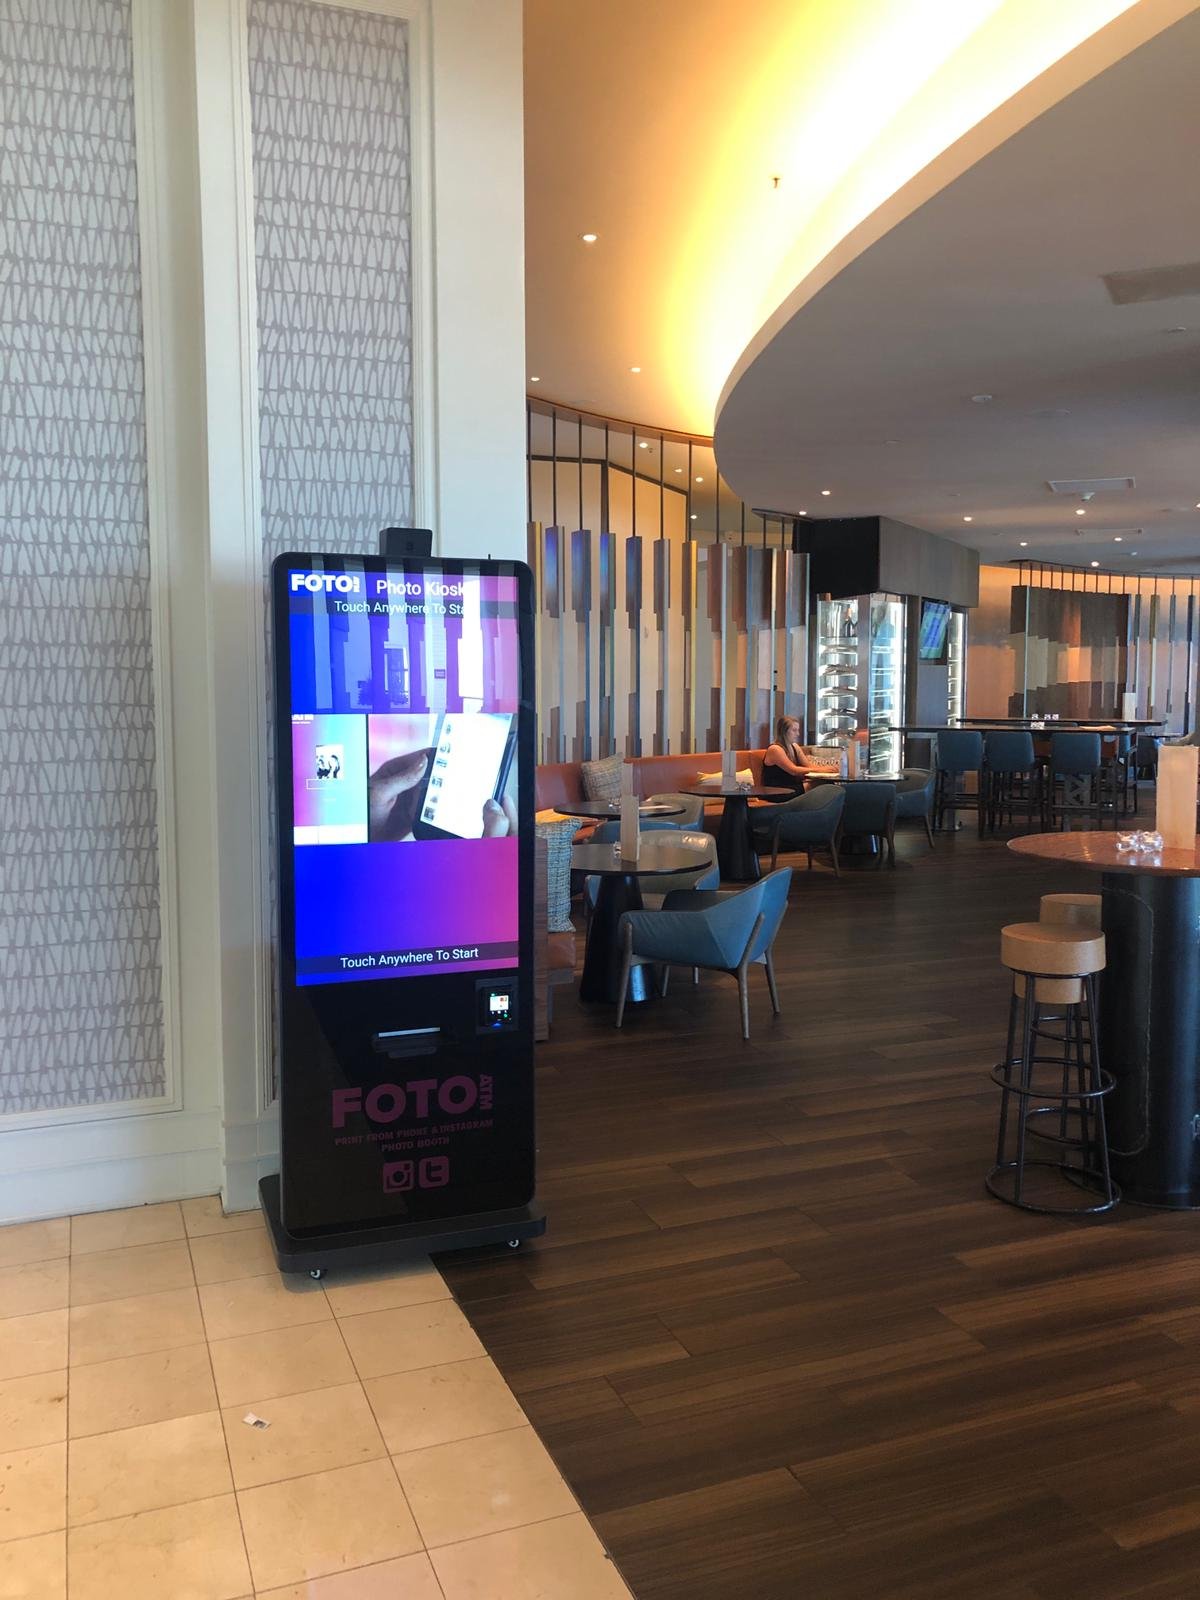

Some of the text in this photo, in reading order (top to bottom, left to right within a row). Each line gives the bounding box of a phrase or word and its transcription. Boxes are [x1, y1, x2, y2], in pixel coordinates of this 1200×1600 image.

[291, 574, 353, 593] FOTO
[376, 580, 422, 596] Photo
[426, 580, 464, 597] Kiosk
[334, 600, 465, 617] Touch Anywhere To Sta
[340, 947, 479, 969] Touch Anywhere To Start
[332, 1075, 478, 1128] FOTO
[335, 1135, 363, 1147] PRINT
[366, 1130, 394, 1143] FROM
[396, 1127, 428, 1139] PHONE
[440, 1119, 494, 1134] INSTAGRAM
[381, 1136, 450, 1152] PHOTO BOOTH
